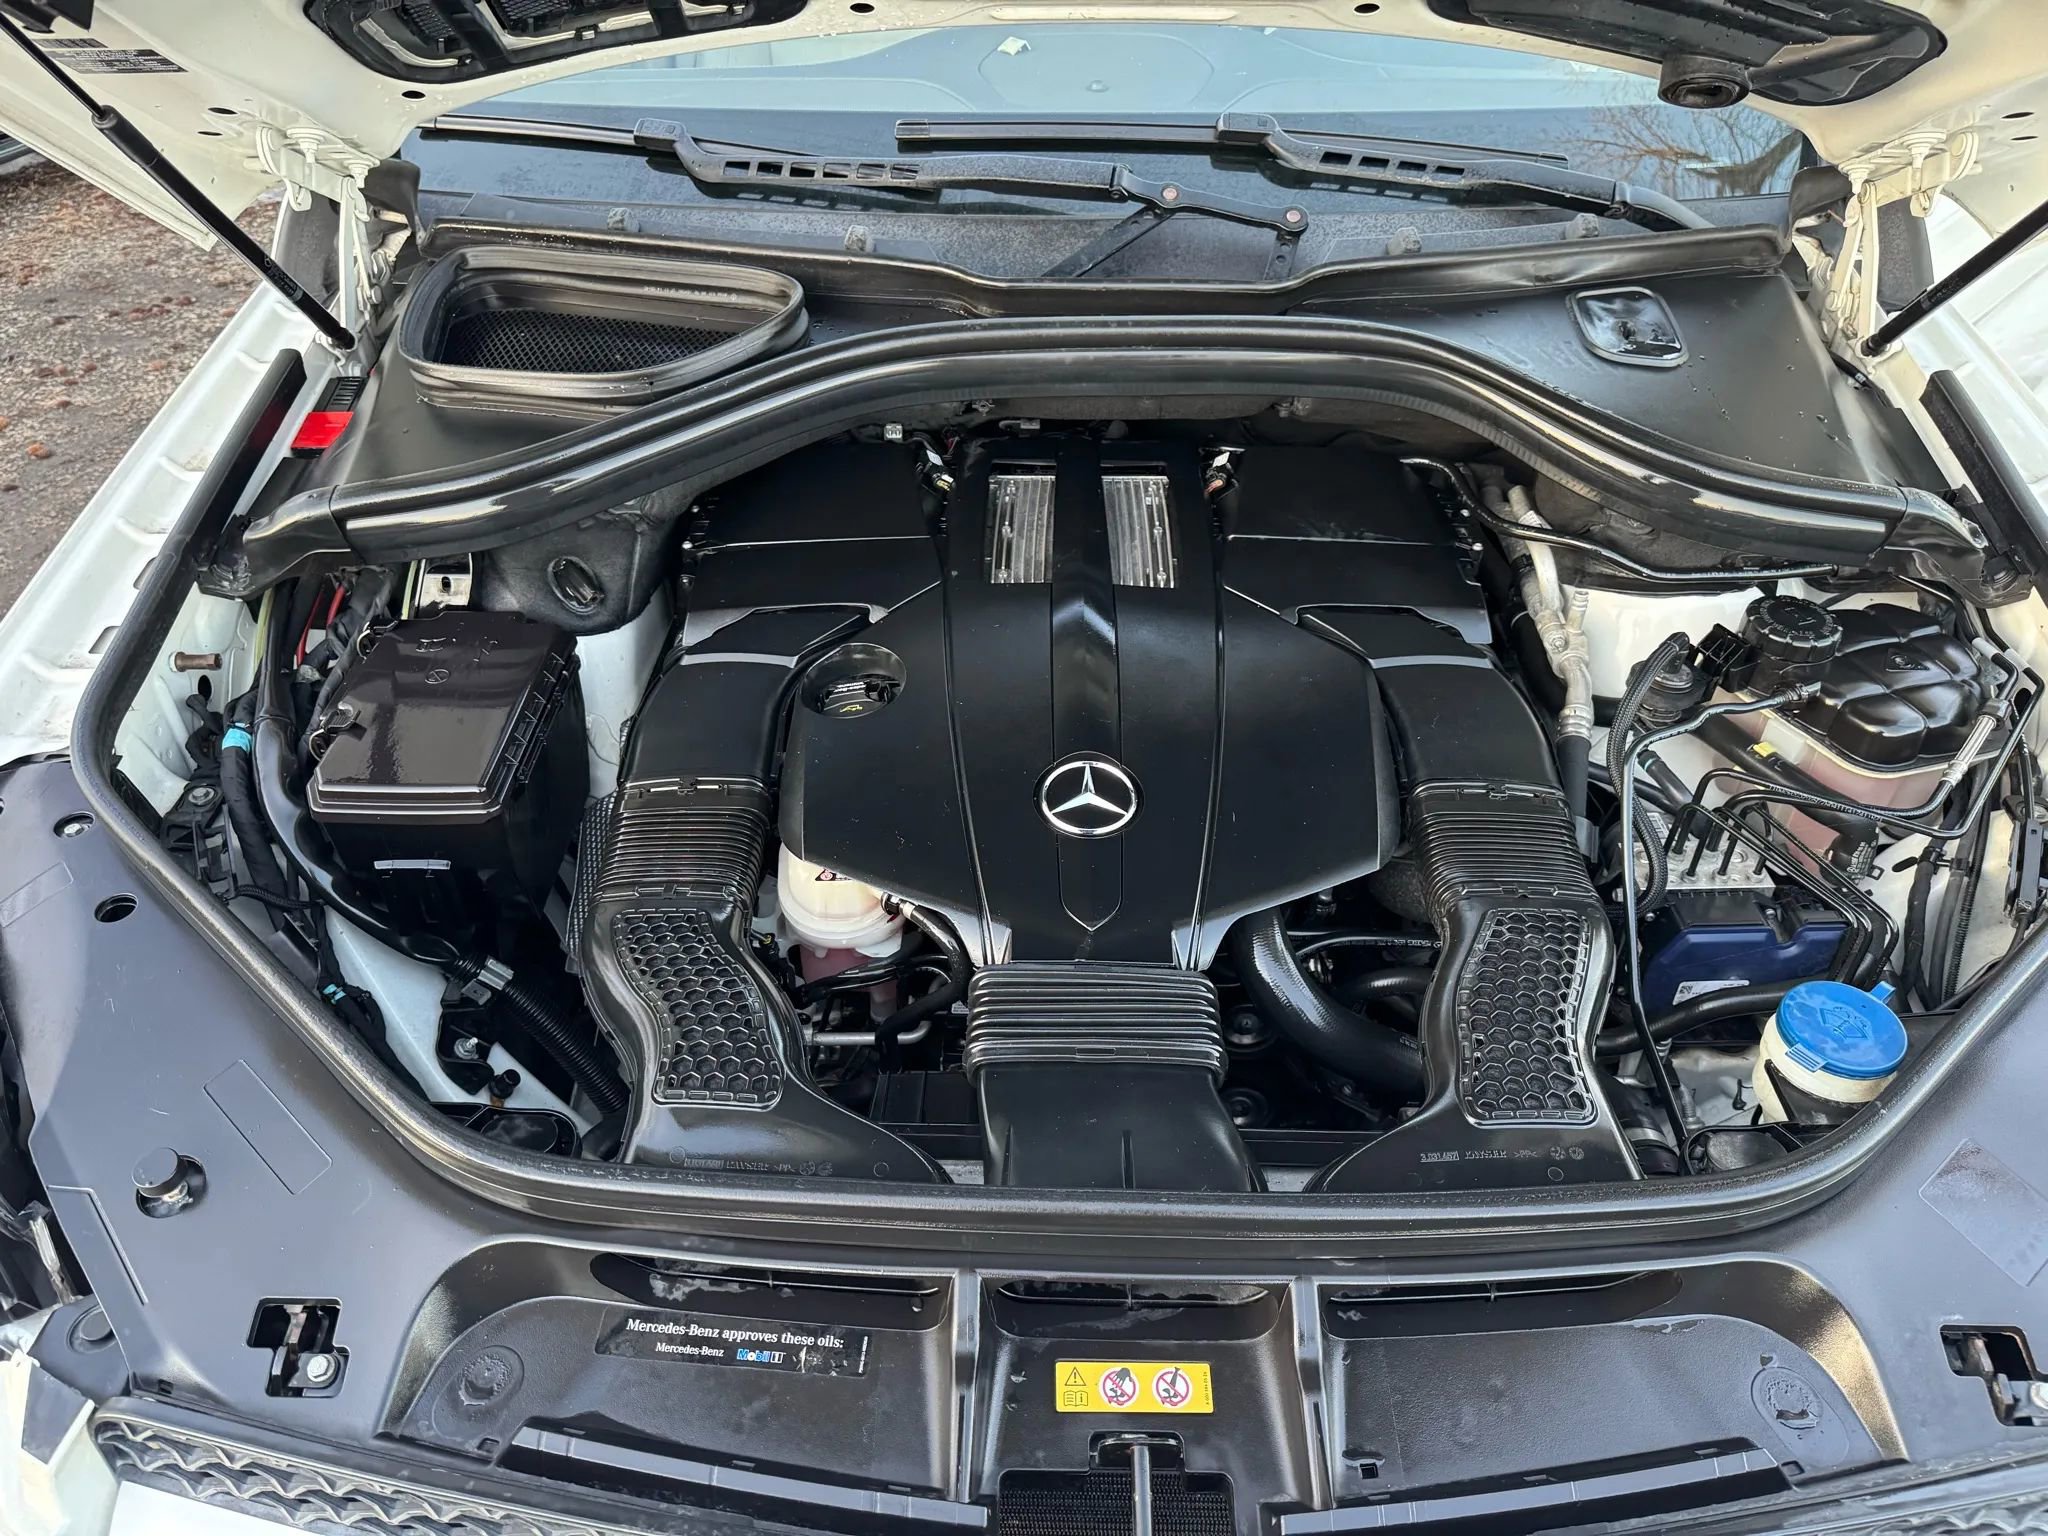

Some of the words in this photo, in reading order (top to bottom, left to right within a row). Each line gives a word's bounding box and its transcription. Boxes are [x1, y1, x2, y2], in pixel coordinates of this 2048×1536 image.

[626, 1318, 721, 1338] Mercedes-Benz
[722, 1328, 779, 1344] approves
[781, 1332, 815, 1346] these
[817, 1335, 845, 1349] oils:
[655, 1342, 724, 1357] Mercedes-Benz
[736, 1348, 770, 1363] Mobil
